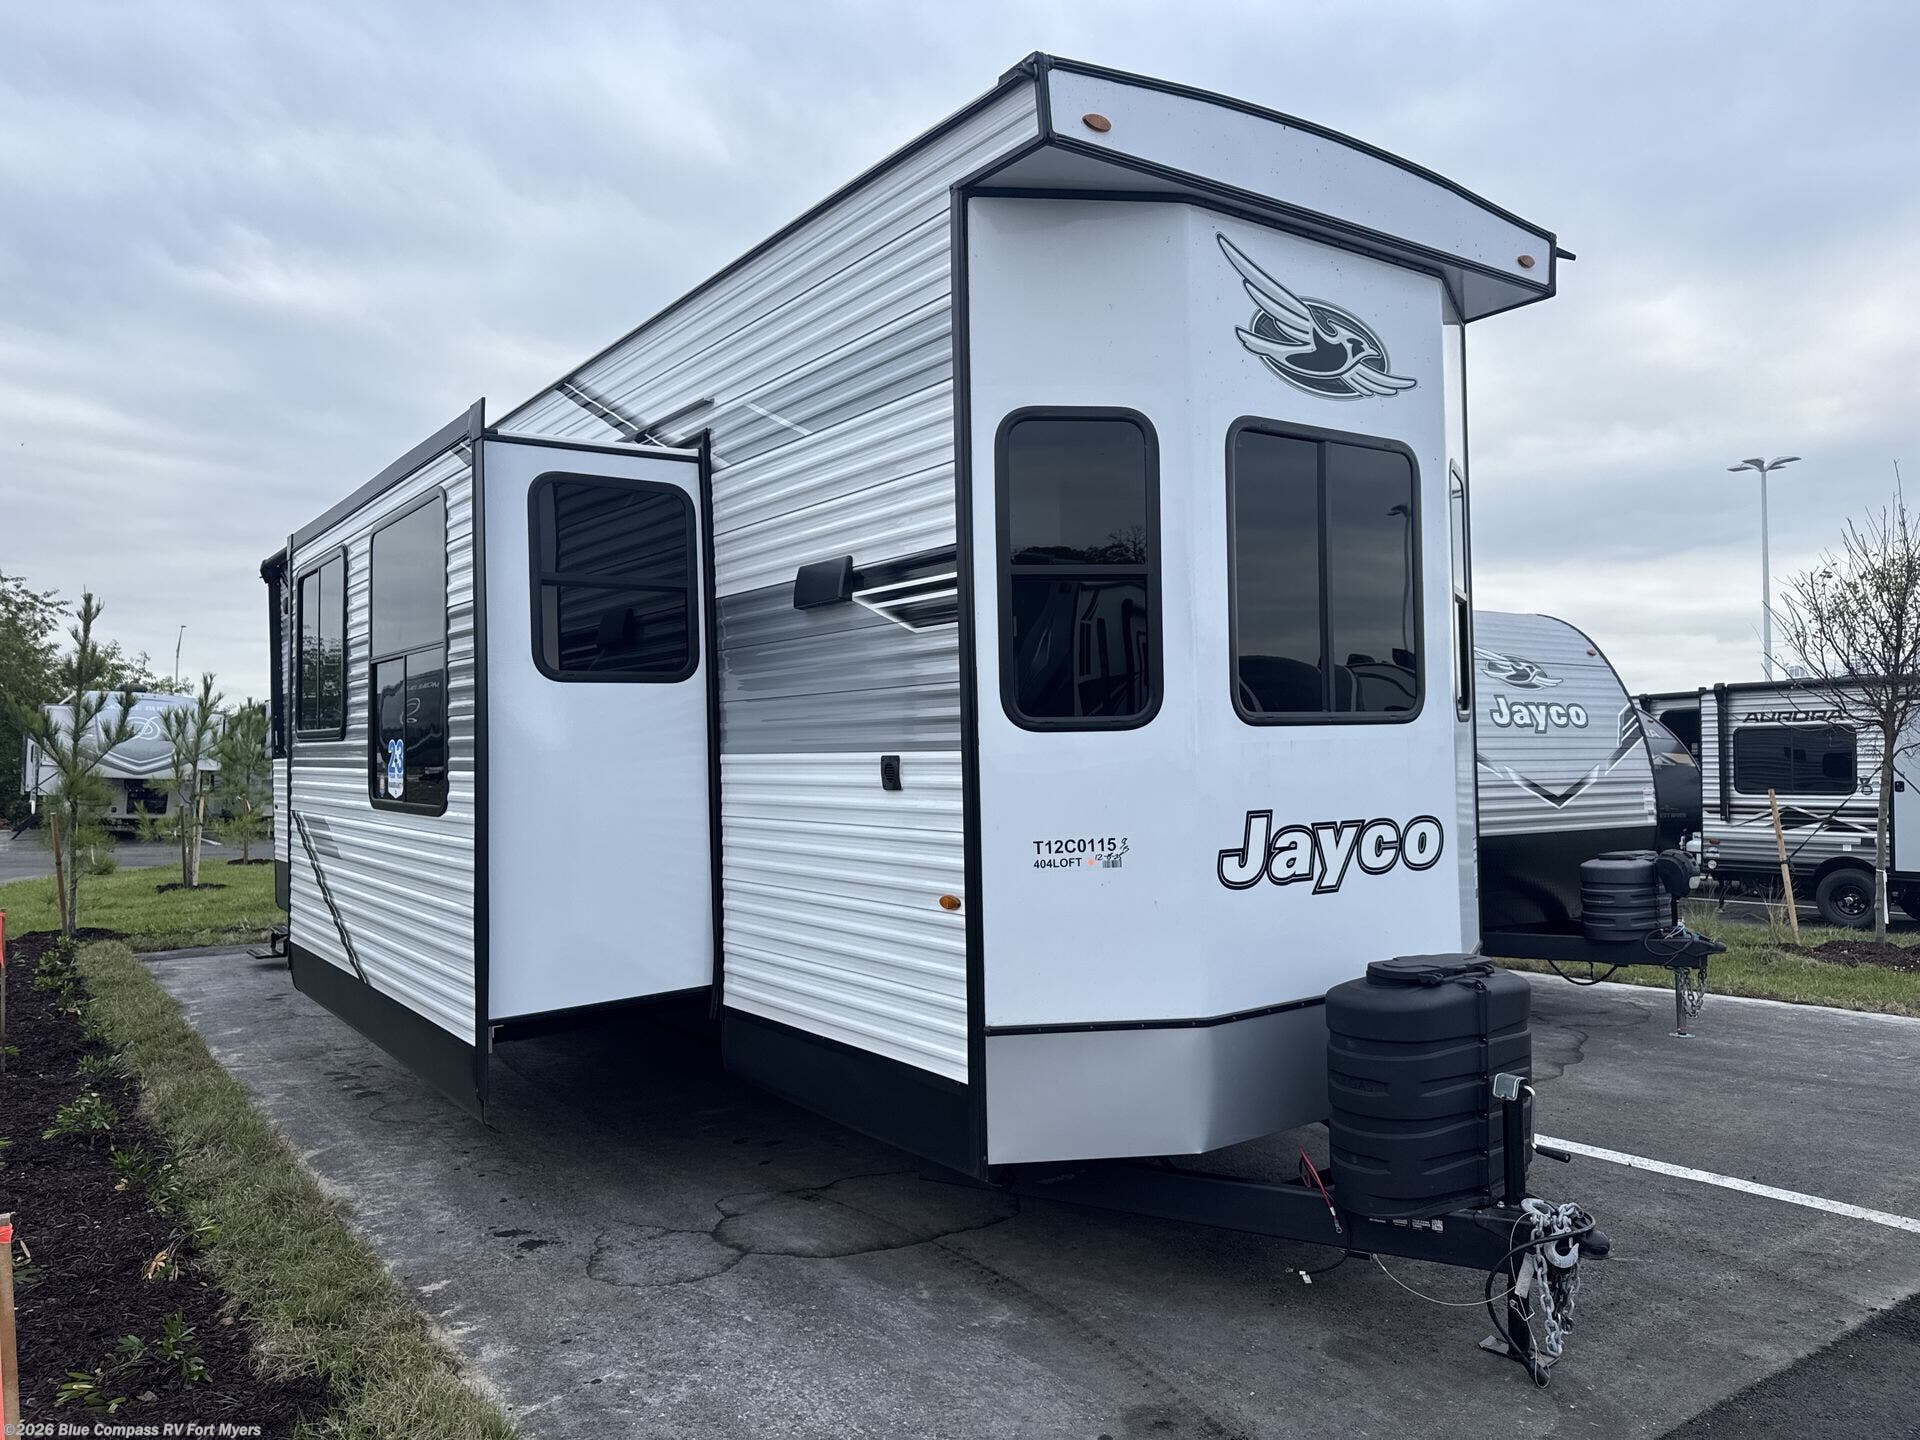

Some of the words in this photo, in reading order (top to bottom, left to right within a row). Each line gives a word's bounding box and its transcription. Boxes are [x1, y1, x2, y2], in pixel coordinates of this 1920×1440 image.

[1489, 694, 1588, 734] Jayco
[1033, 838, 1117, 855] T12C0115
[1217, 809, 1444, 895] Jayco
[1033, 857, 1083, 869] 404LOFT
